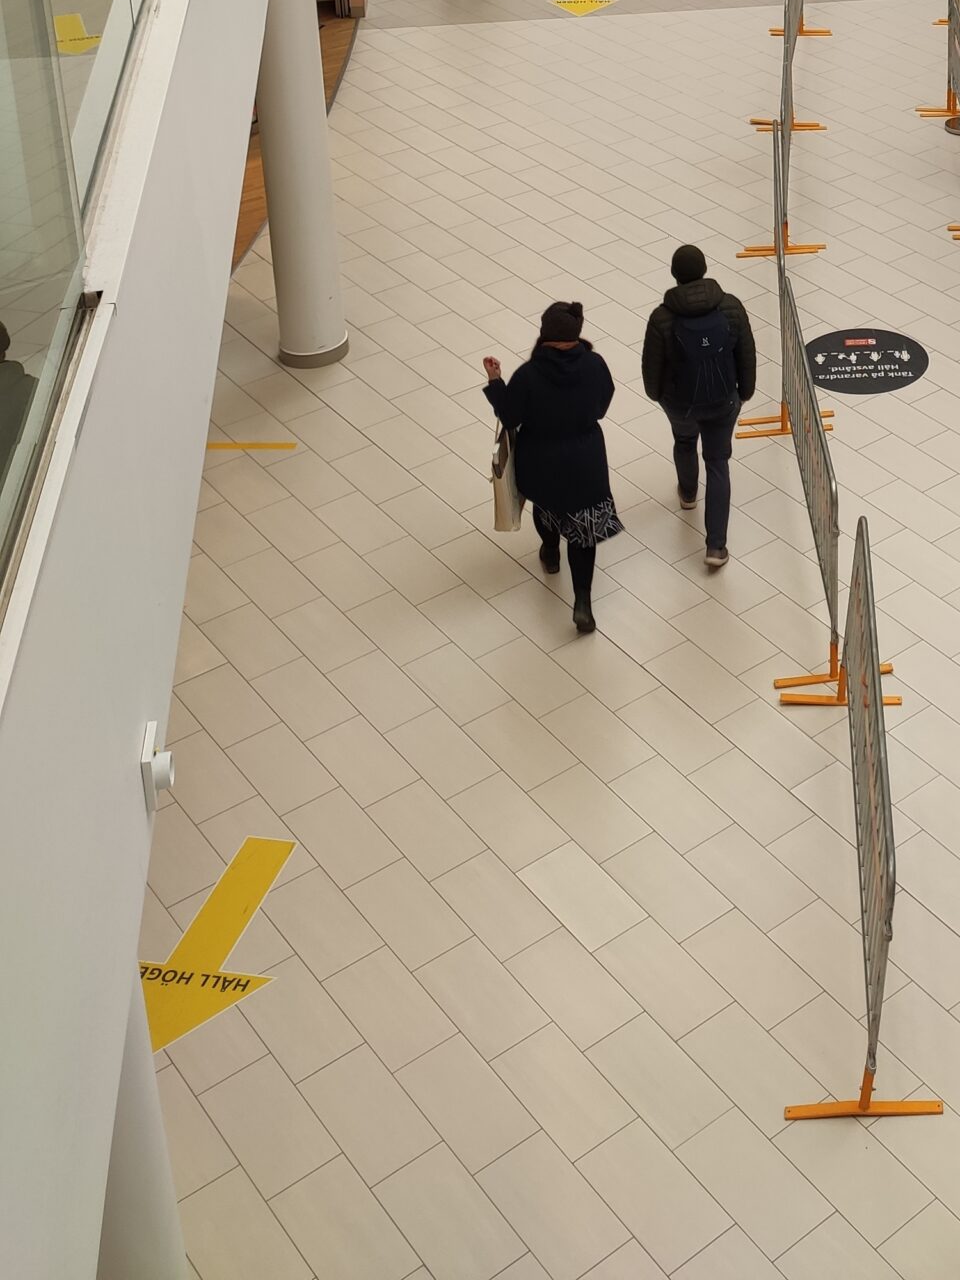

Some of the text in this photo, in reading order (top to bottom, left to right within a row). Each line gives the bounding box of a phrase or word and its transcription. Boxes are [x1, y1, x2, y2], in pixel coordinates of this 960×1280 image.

[828, 365, 875, 373] avstånd.
[815, 372, 869, 380] varandra.
[871, 371, 885, 379] på
[139, 966, 250, 992] HÅLL HÖGE
